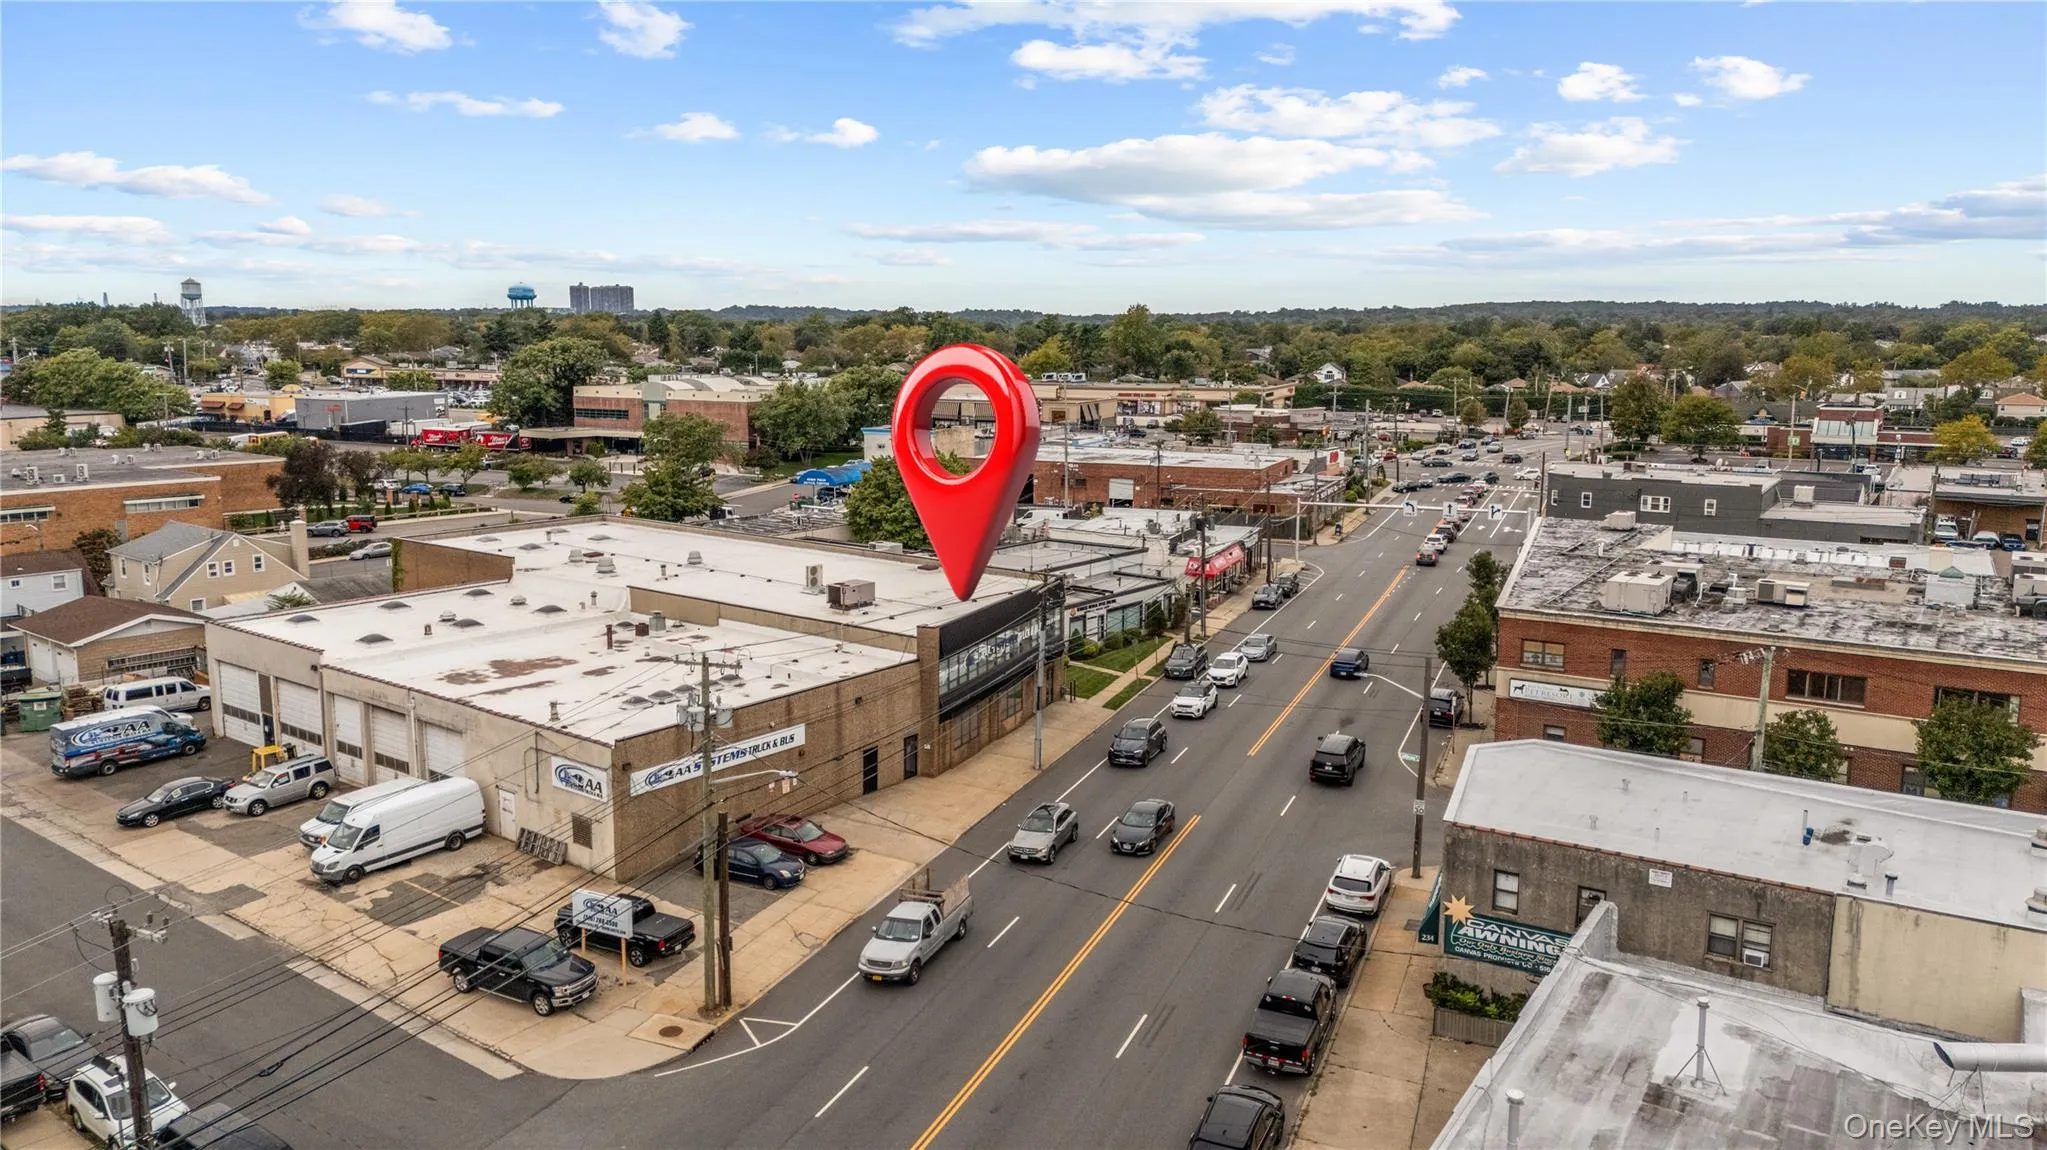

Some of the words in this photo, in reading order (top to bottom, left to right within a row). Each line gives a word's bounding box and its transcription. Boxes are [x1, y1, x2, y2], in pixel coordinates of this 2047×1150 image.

[124, 720, 150, 734] AA
[674, 766, 692, 778] AA
[693, 749, 747, 772] SSTEMS
[748, 743, 771, 755] TRUCK
[584, 778, 603, 794] AA
[1457, 925, 1566, 955] AWNING
[1466, 919, 1570, 945] CANVAS
[1454, 946, 1482, 957] CANVAS
